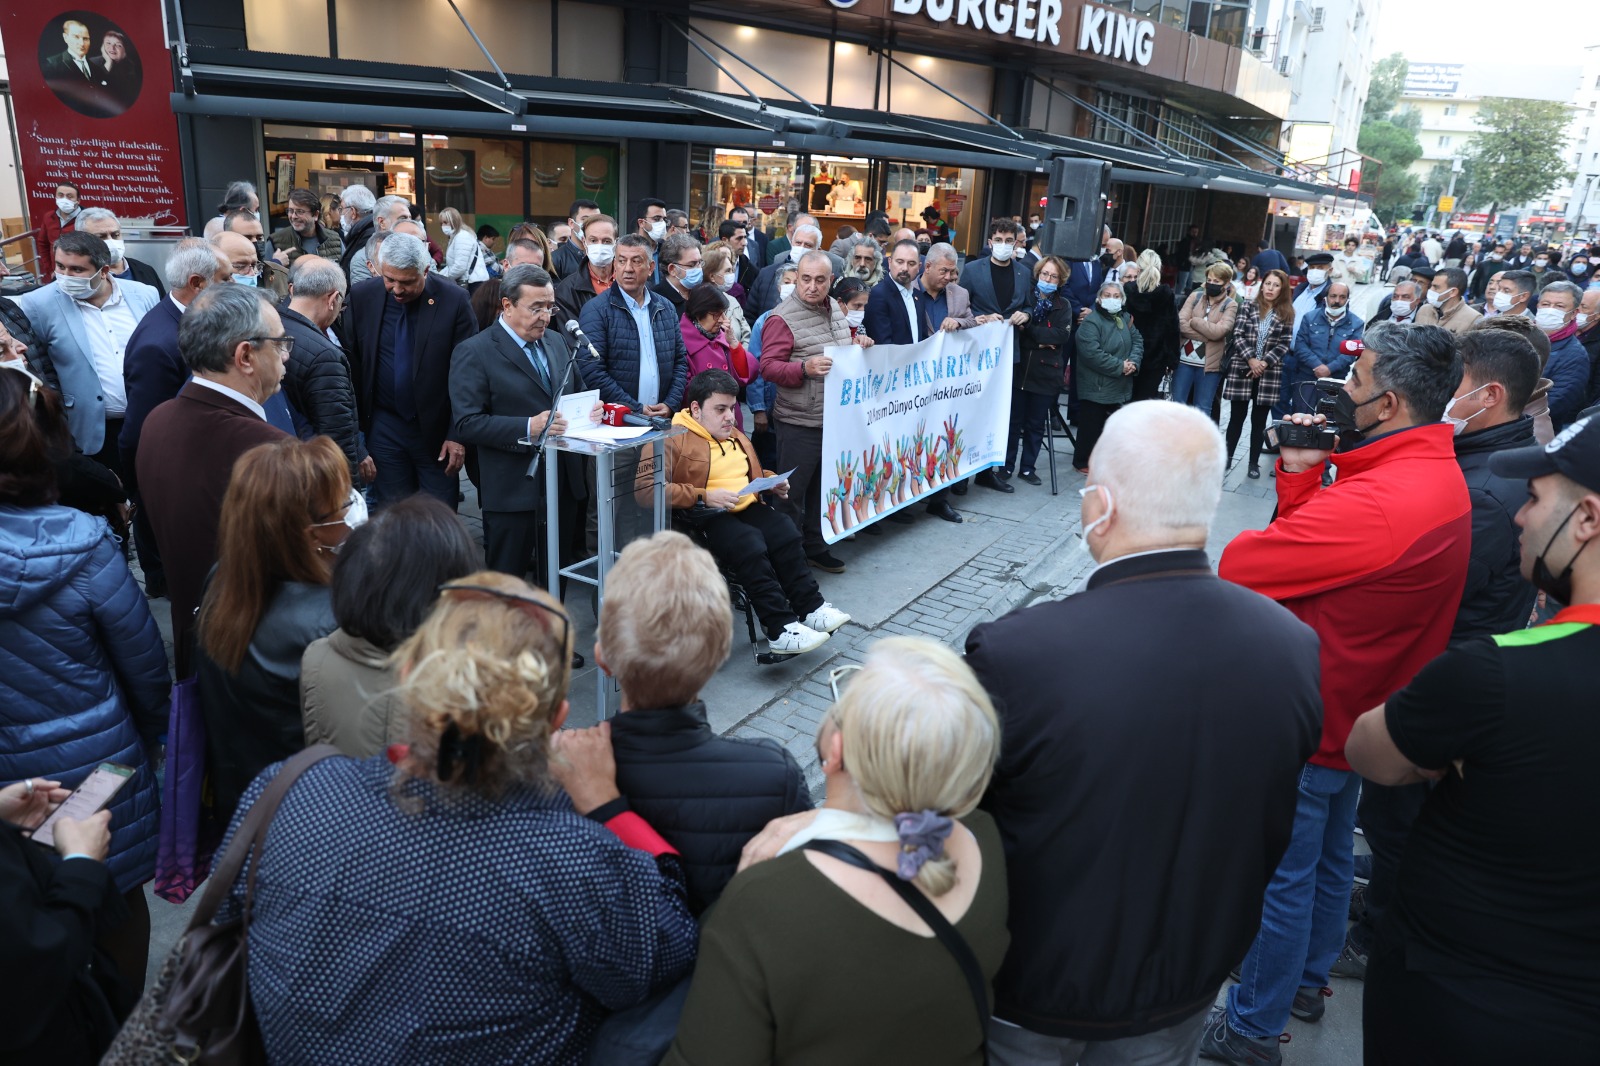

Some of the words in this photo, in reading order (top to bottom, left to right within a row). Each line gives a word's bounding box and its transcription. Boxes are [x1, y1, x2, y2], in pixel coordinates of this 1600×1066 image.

[1077, 4, 1156, 66] KING
[36, 135, 68, 145] Sanat,
[70, 137, 116, 149] güzelliğin
[40, 146, 54, 155] Bu
[56, 147, 81, 156] ifade
[83, 149, 99, 158] söz
[102, 150, 113, 159] ile
[115, 151, 144, 161] olursa
[46, 158, 78, 168] nağme
[80, 160, 92, 169] ile
[94, 161, 124, 170] olursa
[46, 169, 69, 179] nakş
[71, 170, 83, 179] ile
[85, 171, 115, 180] olursa
[37, 181, 58, 190] oym
[80, 182, 110, 191] olursa
[80, 193, 101, 201] ursa
[155, 196, 175, 205] olur
[888, 399, 913, 416] Dünya
[933, 385, 963, 401] Hakları
[964, 379, 982, 396] Günü
